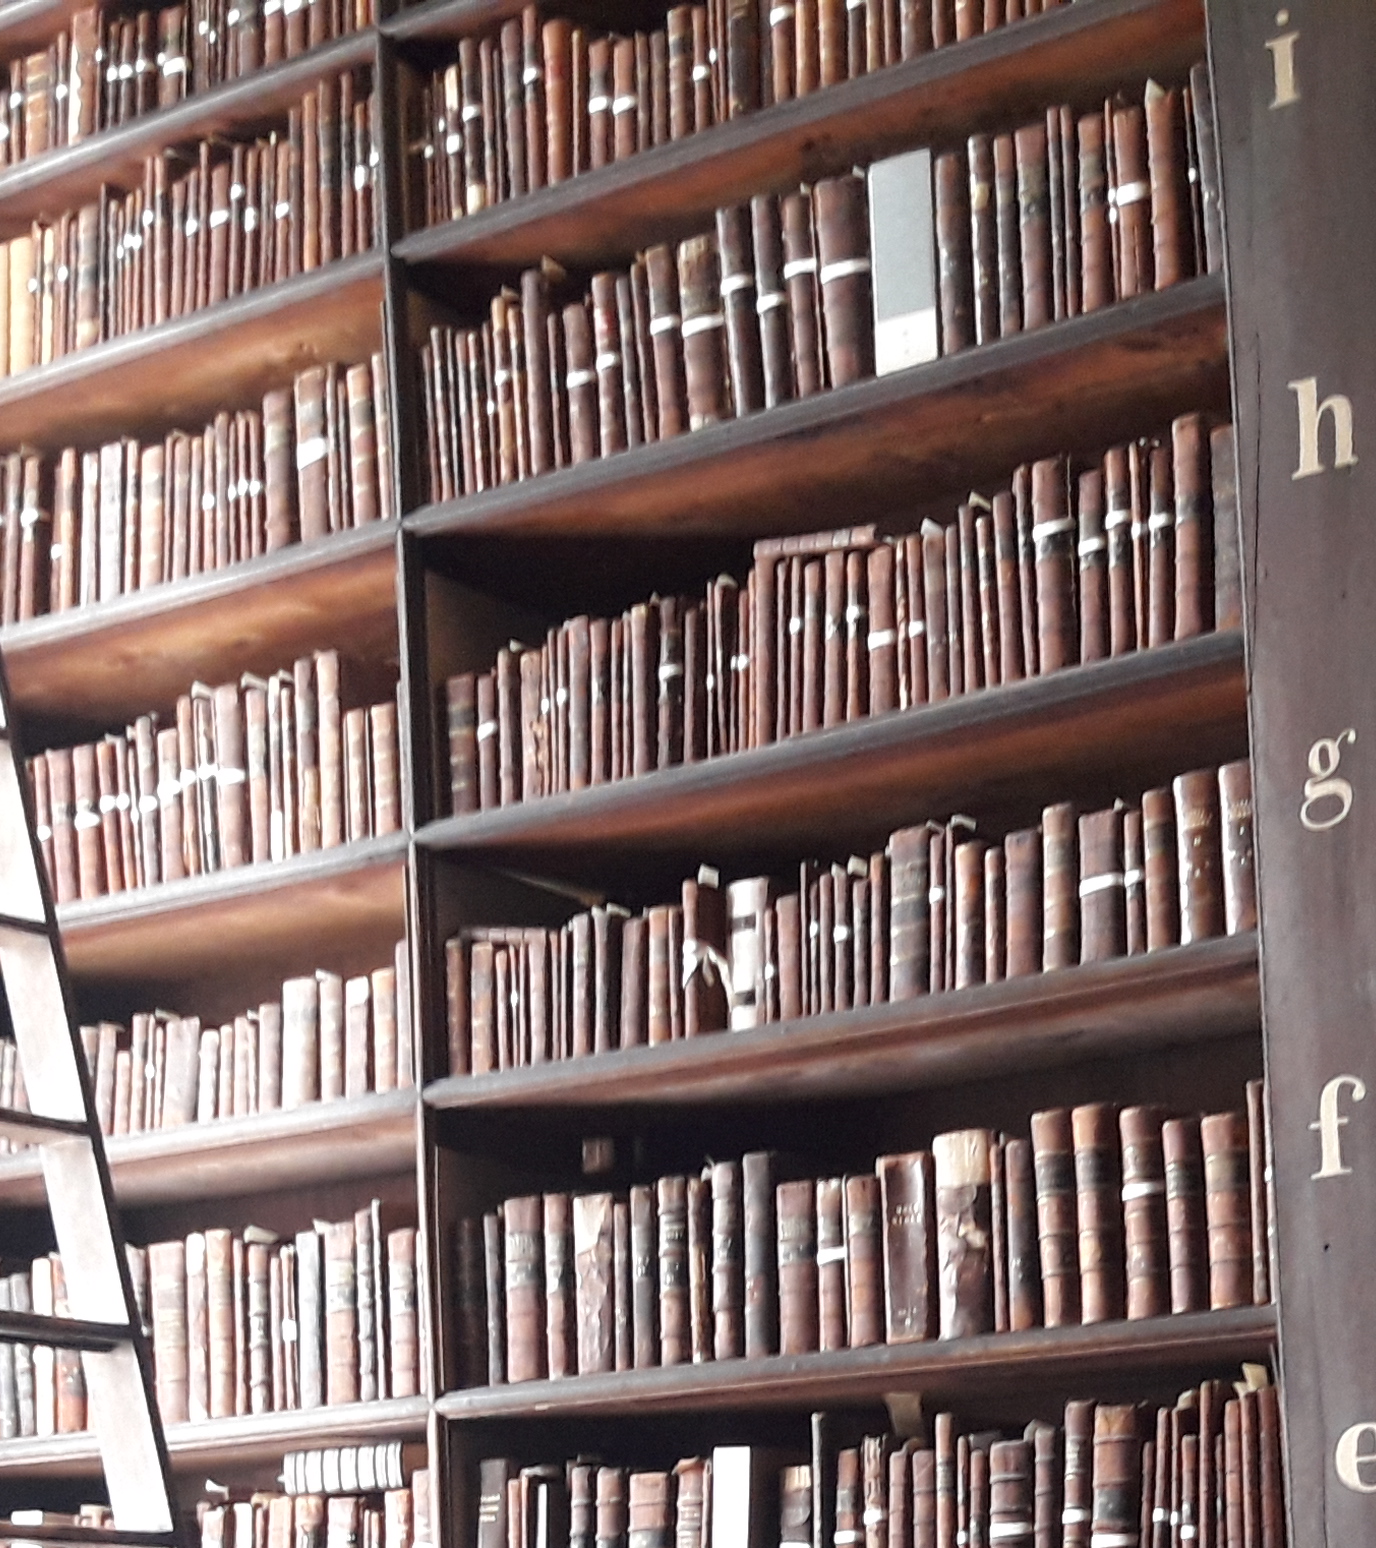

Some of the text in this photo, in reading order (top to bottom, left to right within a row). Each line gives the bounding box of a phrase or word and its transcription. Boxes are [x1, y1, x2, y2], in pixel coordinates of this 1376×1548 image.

[1265, 8, 1301, 110] i
[1287, 376, 1358, 480] h
[1300, 727, 1357, 833] g
[1308, 1073, 1366, 1180] f
